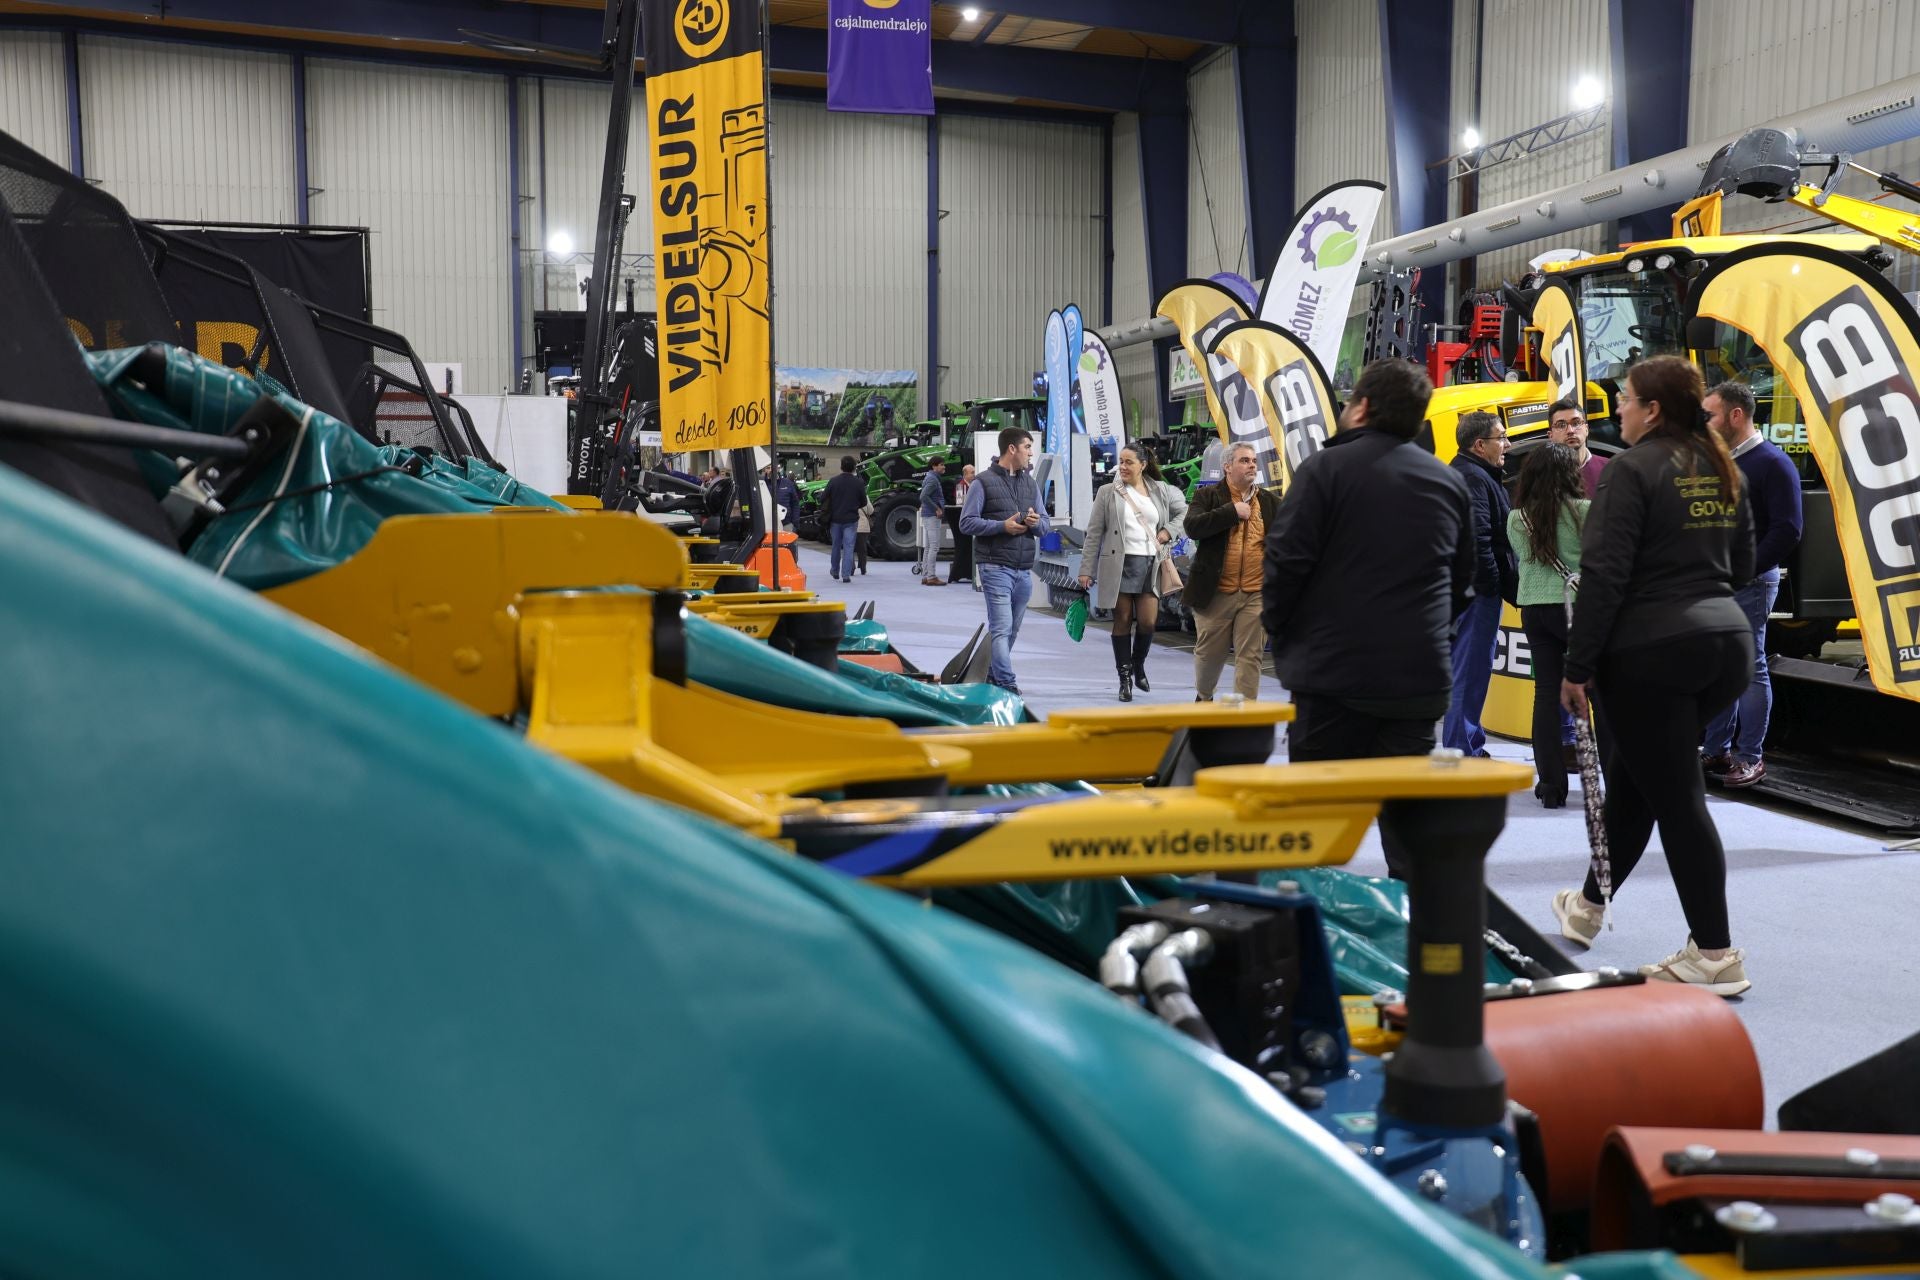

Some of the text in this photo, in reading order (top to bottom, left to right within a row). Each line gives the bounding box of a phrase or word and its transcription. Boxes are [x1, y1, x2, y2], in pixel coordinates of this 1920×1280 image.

[835, 15, 928, 34] cajalmendralejo
[658, 92, 702, 393] VIDELSUR
[675, 398, 767, 443] desde 1968
[577, 437, 591, 480] TOYOTA
[1688, 500, 1737, 518] GOYA
[1048, 830, 1313, 859] www.videlsur.es
